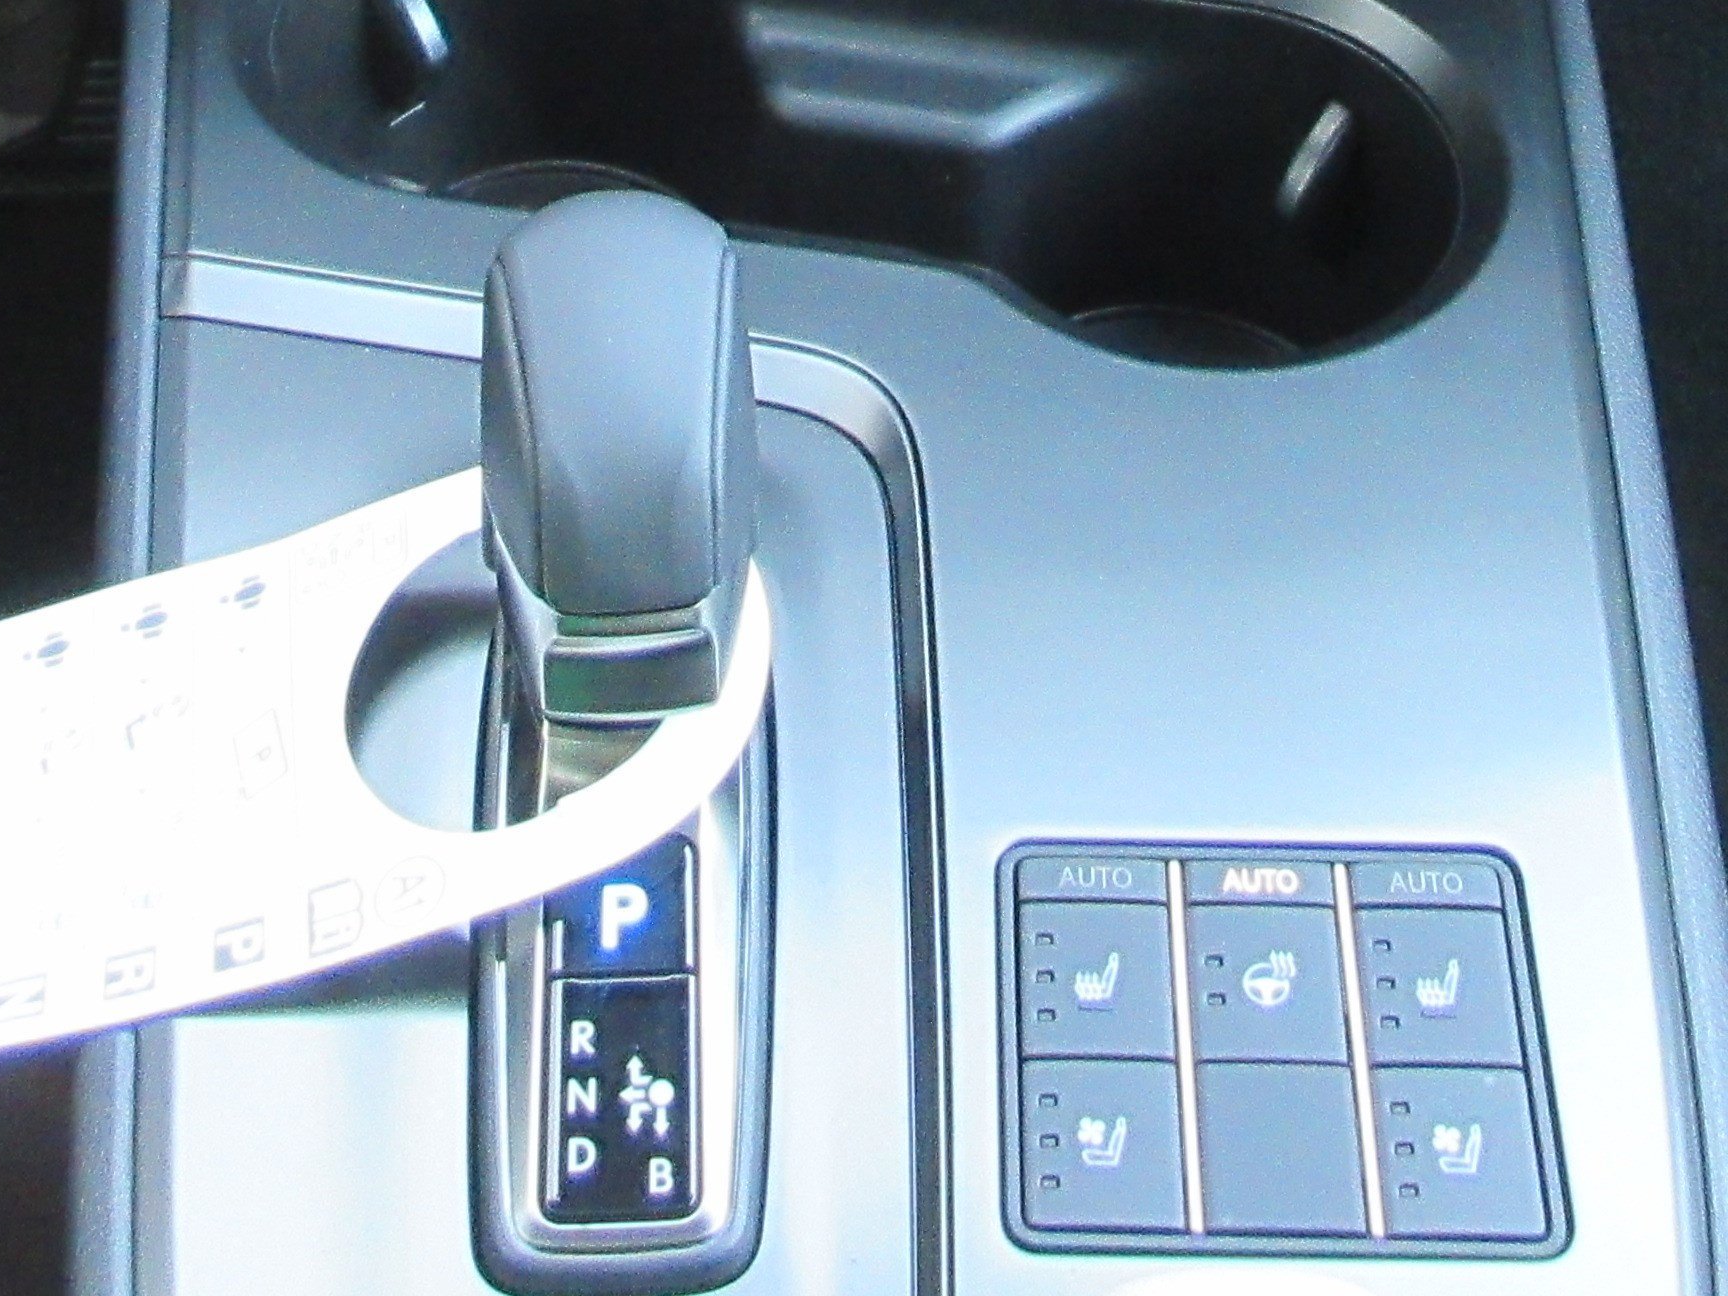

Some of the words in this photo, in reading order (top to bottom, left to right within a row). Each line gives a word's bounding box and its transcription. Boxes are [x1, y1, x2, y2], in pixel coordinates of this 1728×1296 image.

[1058, 865, 1133, 890] AUTO
[1221, 867, 1300, 895] AUTO
[1389, 870, 1464, 896] AUTO
[597, 881, 652, 953] P
[569, 1020, 598, 1056] R
[567, 1078, 598, 1115] N
[567, 1137, 598, 1174] D
[647, 1157, 675, 1195] B
